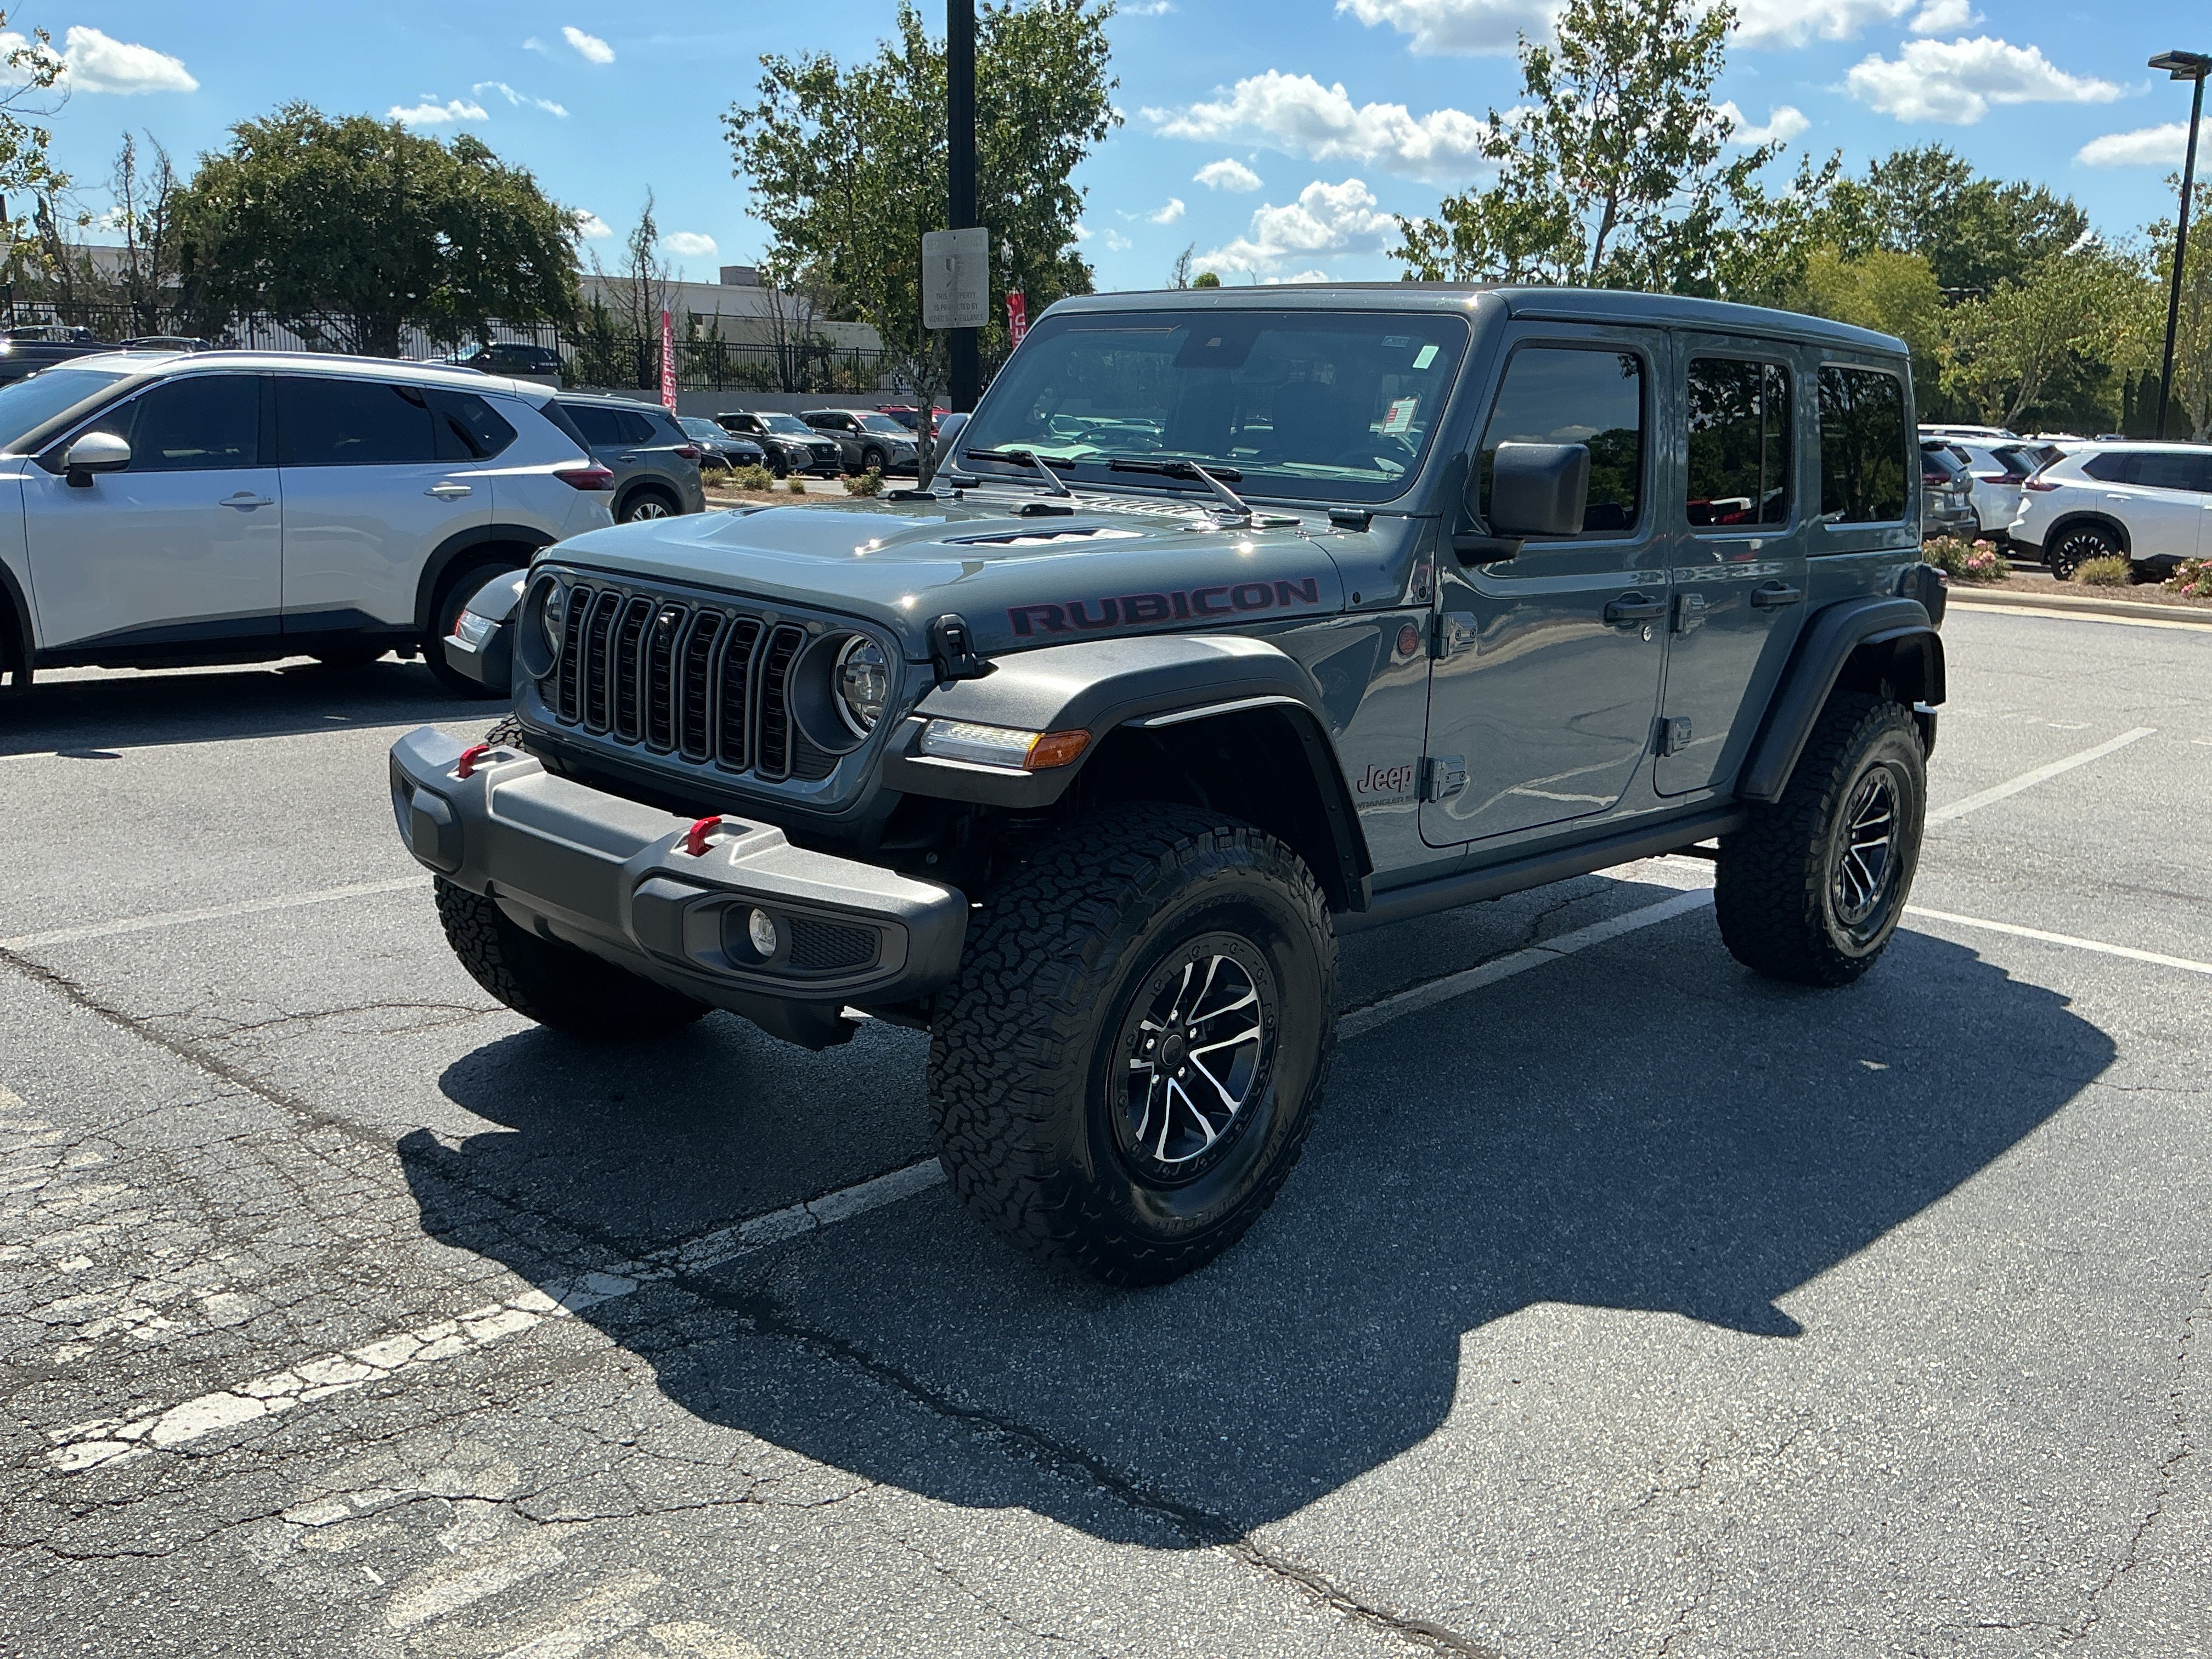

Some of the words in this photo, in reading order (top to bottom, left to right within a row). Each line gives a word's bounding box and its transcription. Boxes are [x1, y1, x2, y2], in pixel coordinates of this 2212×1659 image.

[926, 237, 958, 251] SECUR
[945, 313, 984, 322] SUEILLANCE
[1006, 577, 1320, 637] RUBICON
[1357, 763, 1413, 794] Jeep
